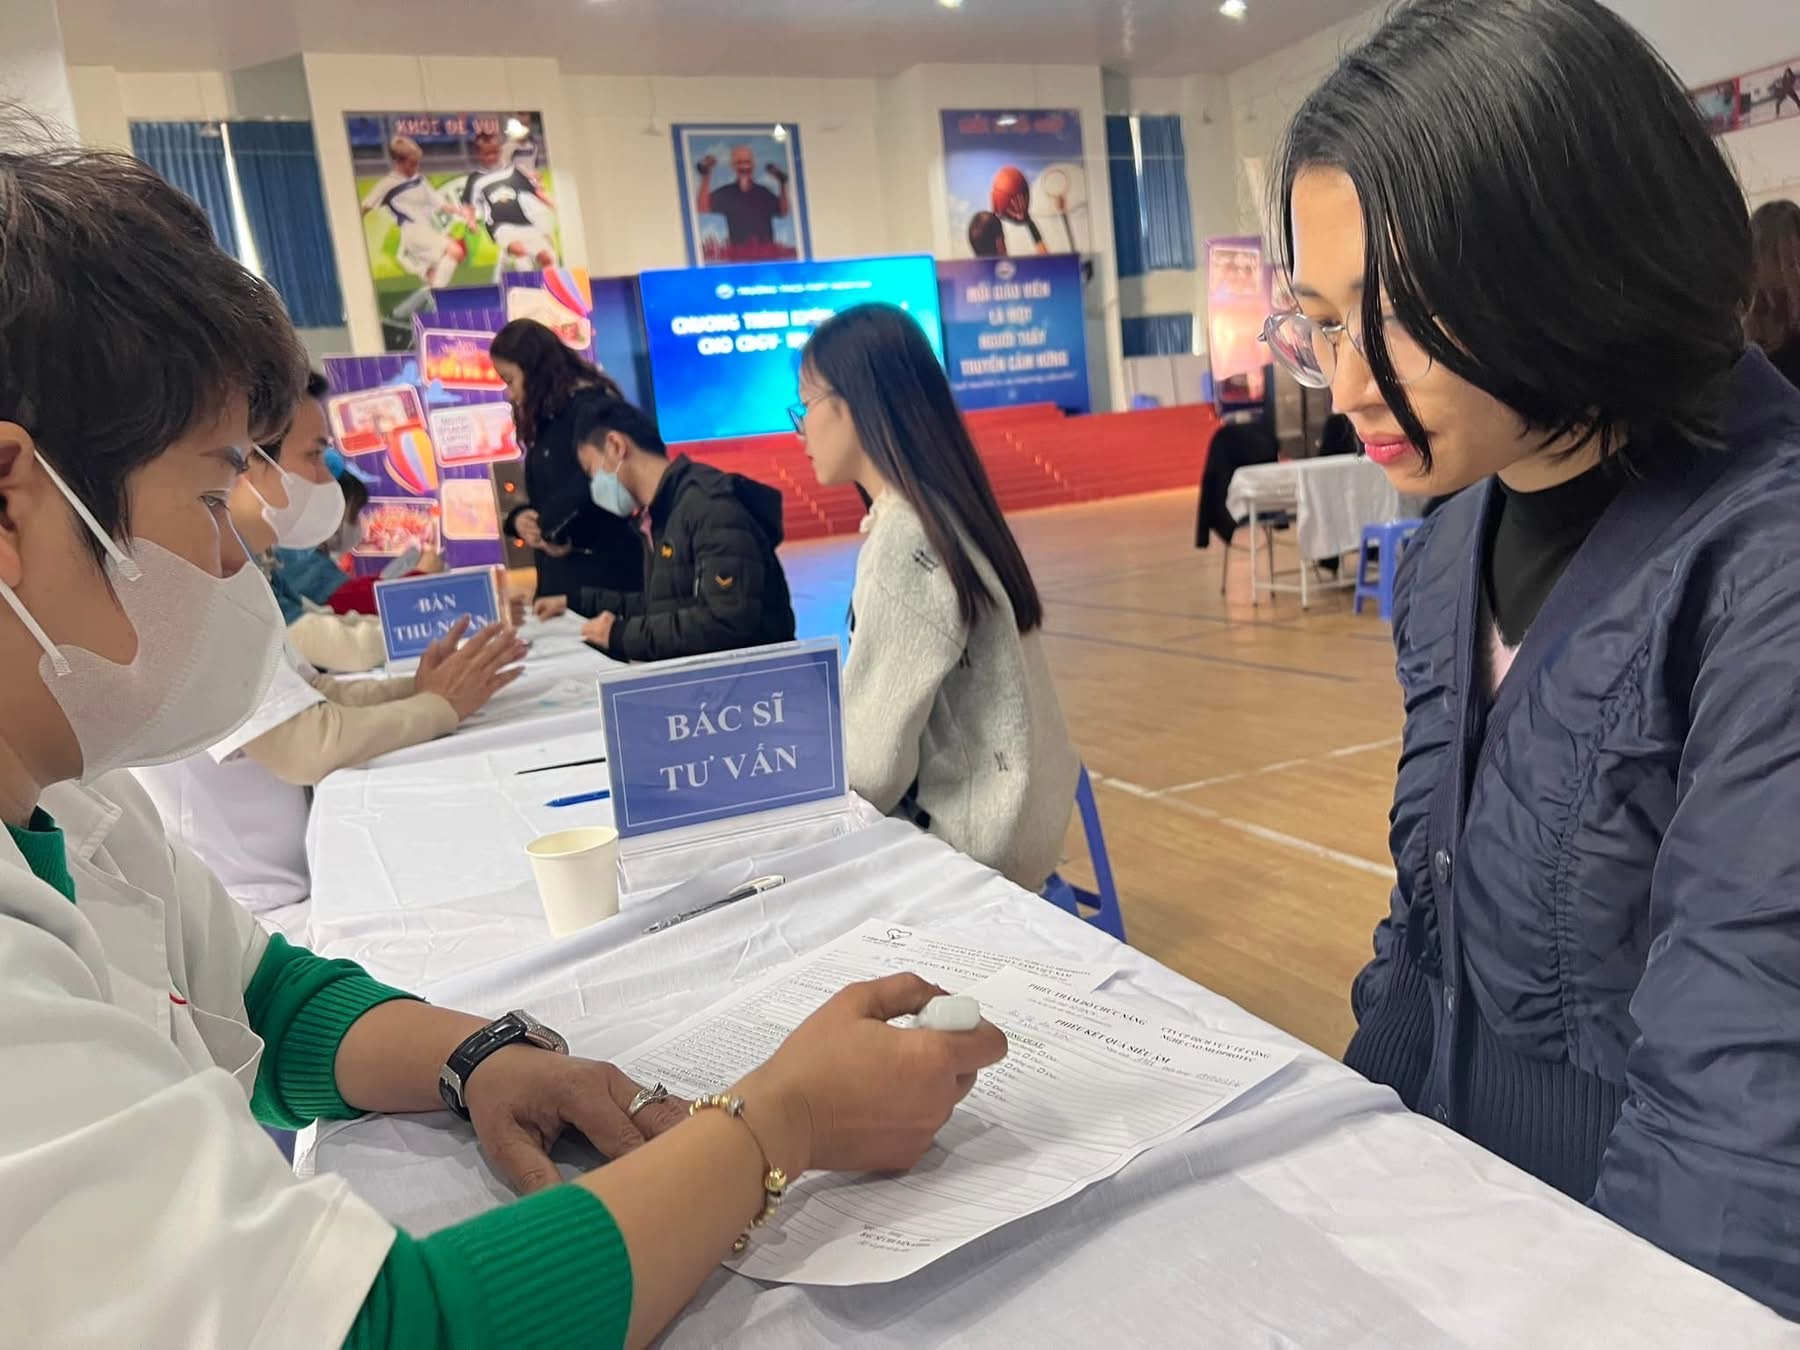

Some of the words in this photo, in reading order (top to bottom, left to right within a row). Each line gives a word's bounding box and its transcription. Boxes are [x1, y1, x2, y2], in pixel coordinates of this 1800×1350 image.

[394, 621, 432, 641] THU
[667, 702, 742, 741] BÁC
[752, 691, 785, 727] SĨ
[660, 755, 714, 792] TƯ
[723, 743, 798, 780] VẤN
